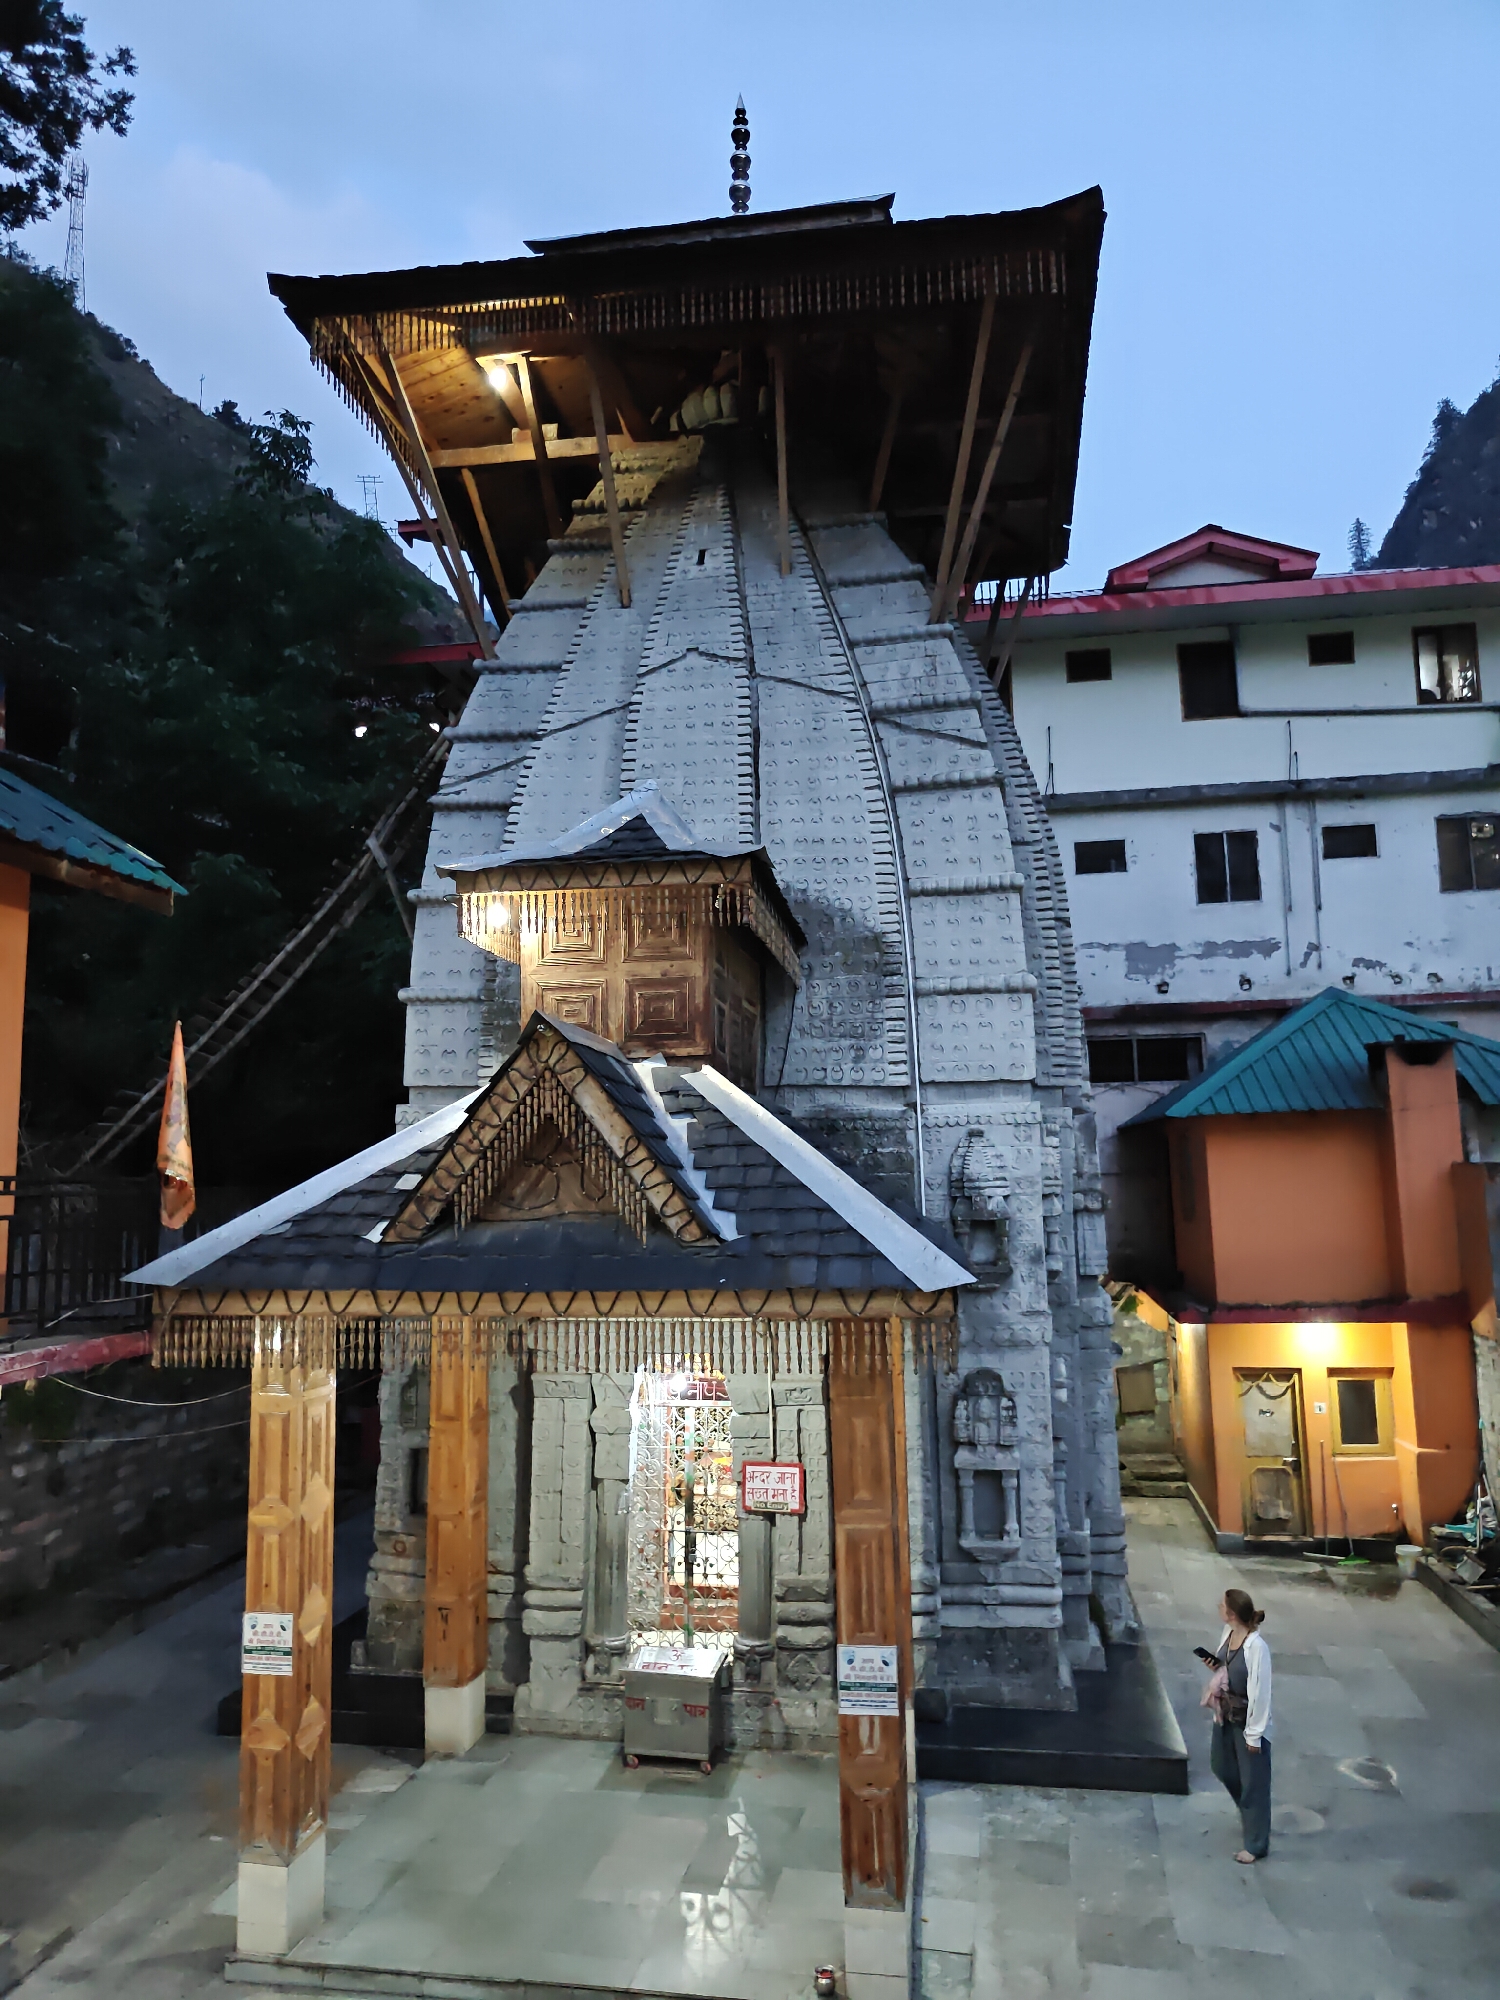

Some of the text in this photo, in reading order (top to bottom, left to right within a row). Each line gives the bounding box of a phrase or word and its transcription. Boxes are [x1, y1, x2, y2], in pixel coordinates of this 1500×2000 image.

[746, 1470, 798, 1485] अन्दर जाना
[770, 1488, 788, 1501] मना
[790, 1484, 797, 1500] है
[682, 1703, 710, 1719] पात्र
